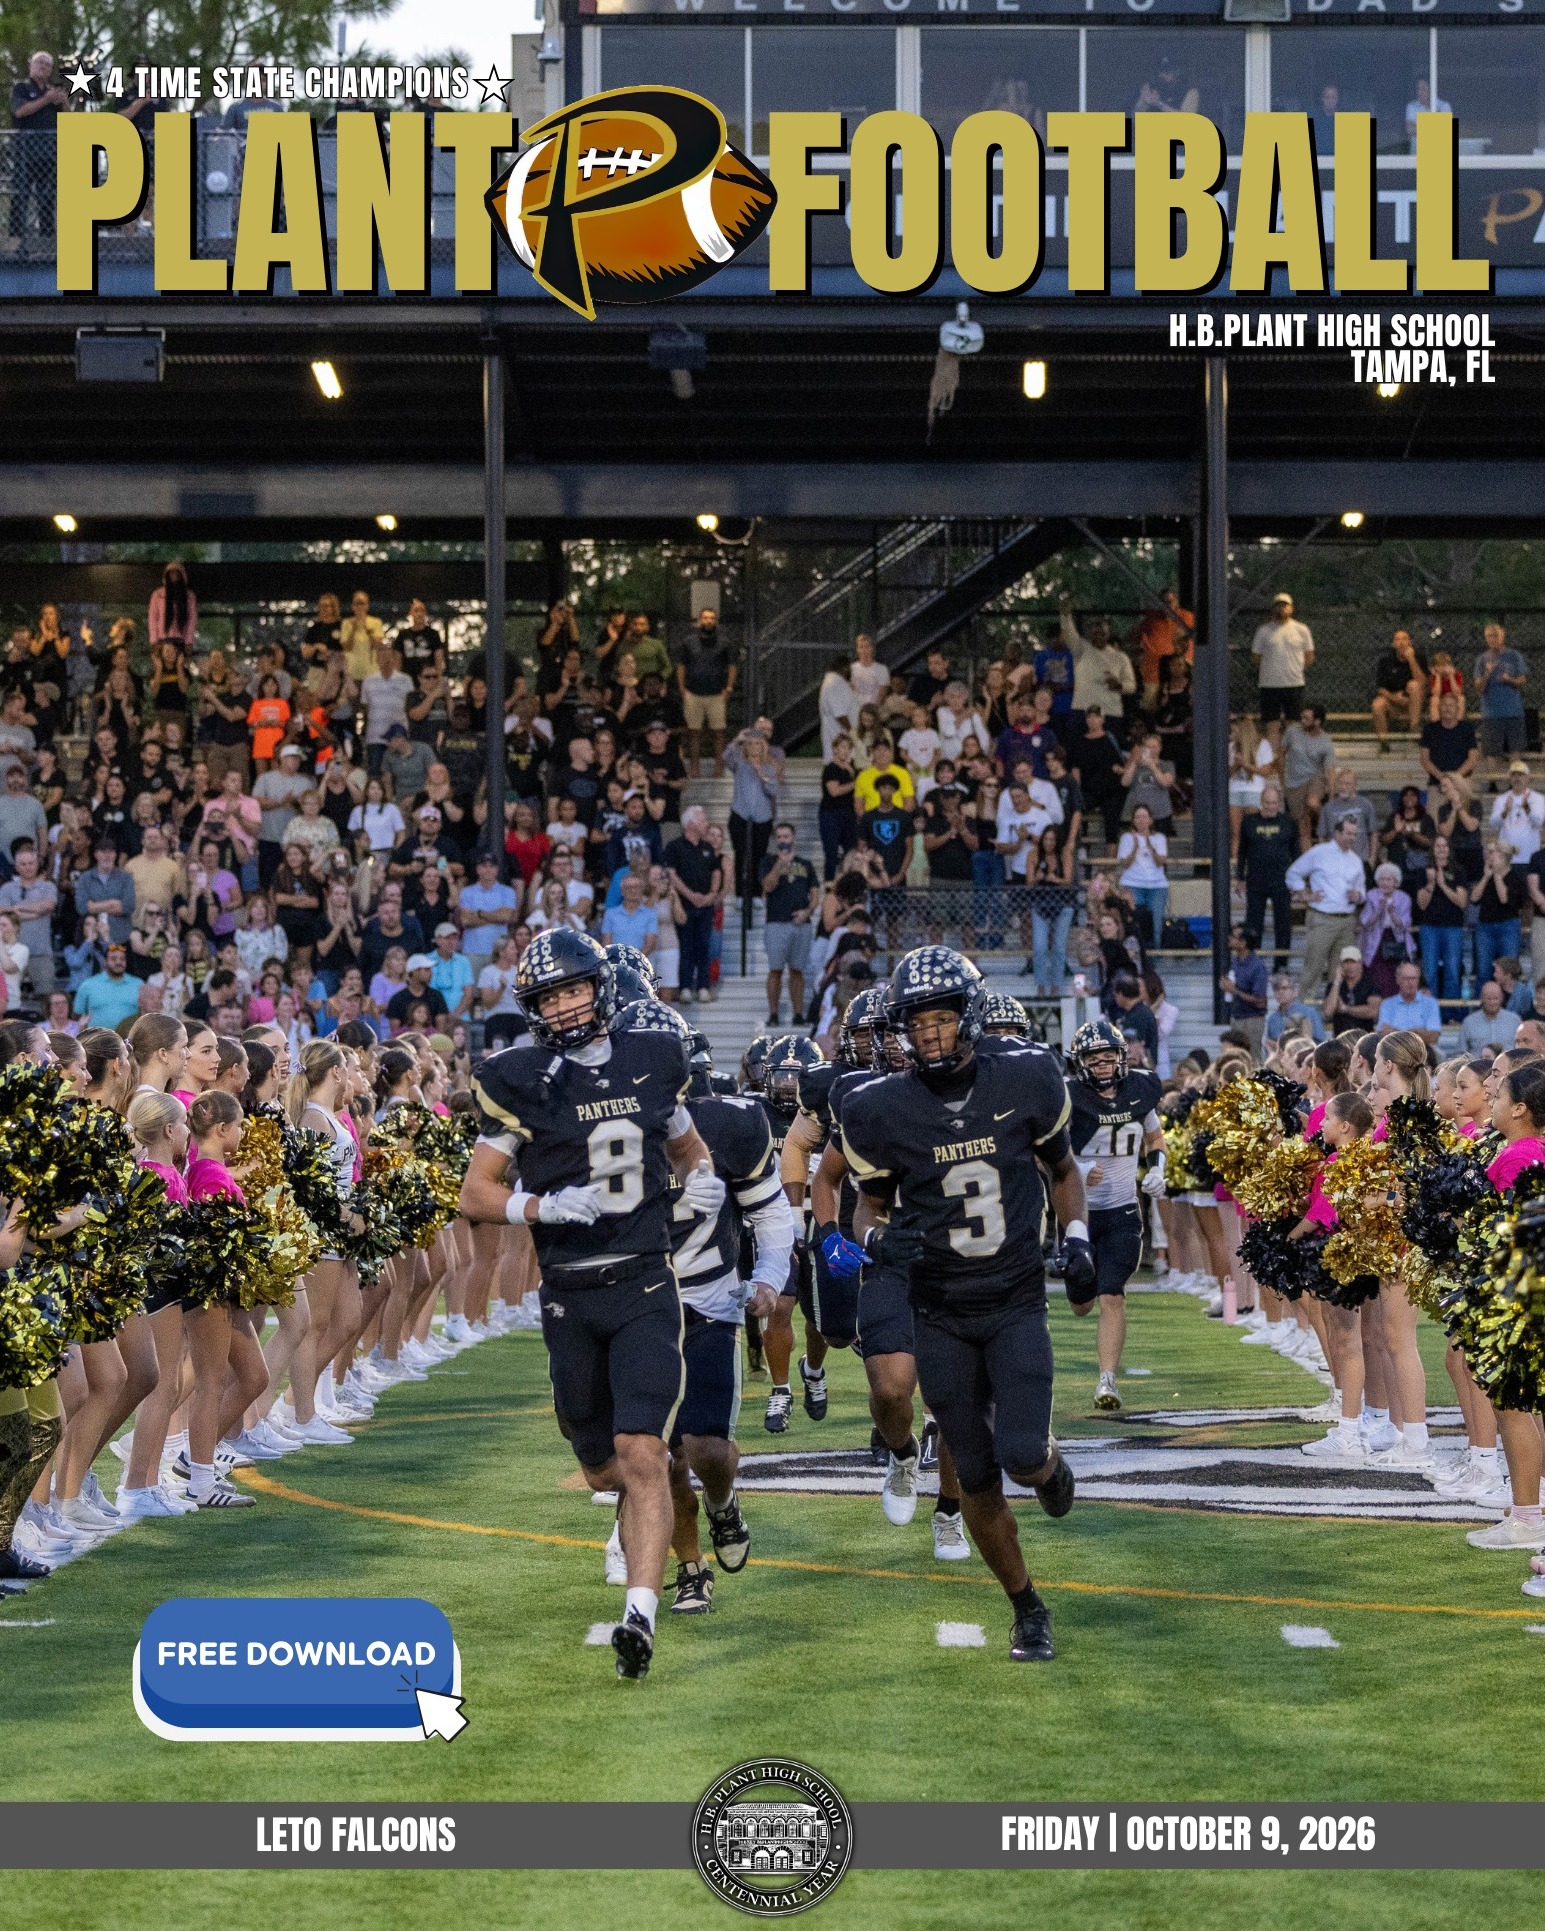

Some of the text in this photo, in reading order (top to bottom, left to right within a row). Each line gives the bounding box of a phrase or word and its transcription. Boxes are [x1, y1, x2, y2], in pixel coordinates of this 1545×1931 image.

[576, 1096, 642, 1122] PANTHERS
[1098, 1111, 1132, 1125] PANTHERS
[932, 1136, 997, 1163] PANTHERS
[587, 1118, 645, 1214] 8
[941, 1159, 1007, 1257] 3
